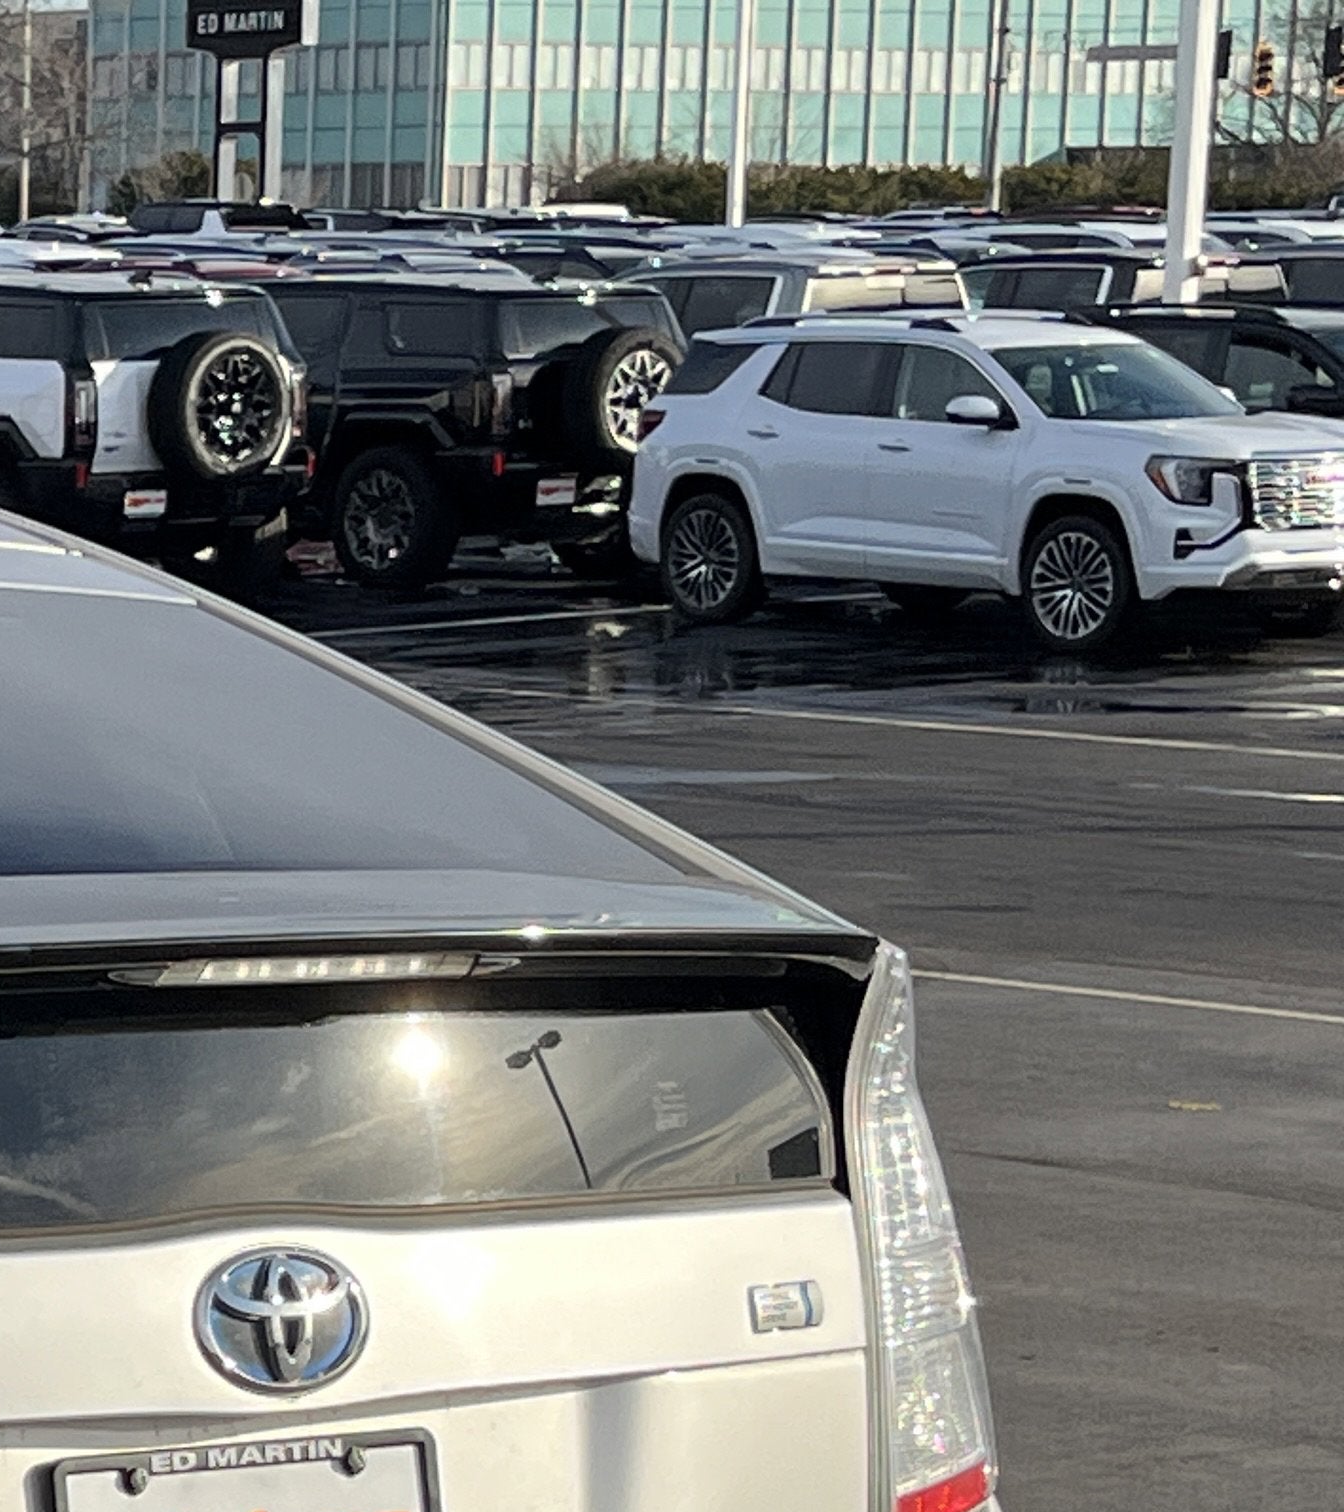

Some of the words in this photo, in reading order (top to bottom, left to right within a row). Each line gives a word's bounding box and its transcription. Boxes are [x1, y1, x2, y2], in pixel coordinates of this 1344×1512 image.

[197, 13, 218, 34] ED
[224, 11, 284, 32] MARTIN
[150, 1453, 196, 1474] ED
[208, 1439, 345, 1470] MARTIN
